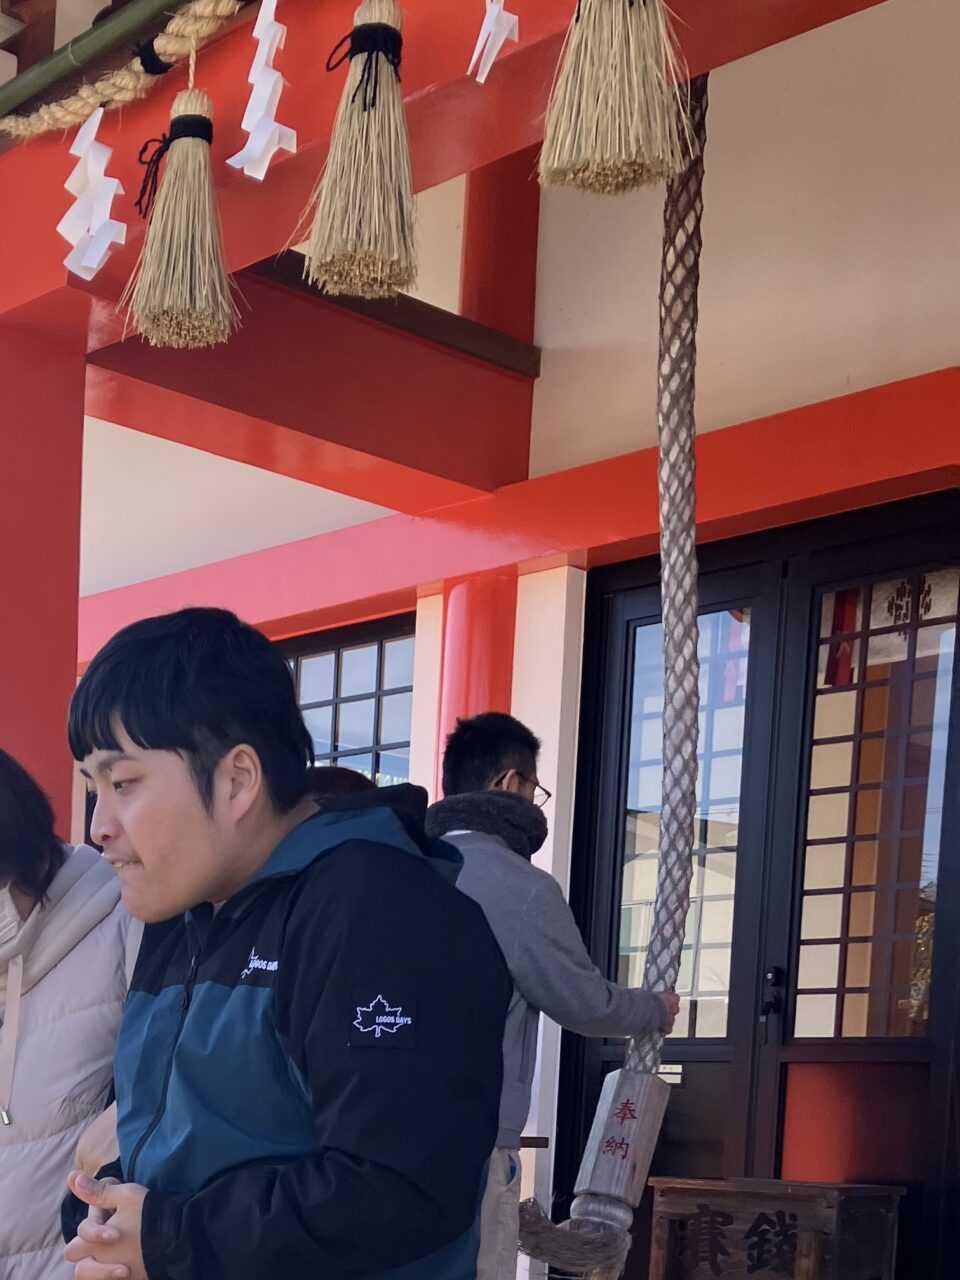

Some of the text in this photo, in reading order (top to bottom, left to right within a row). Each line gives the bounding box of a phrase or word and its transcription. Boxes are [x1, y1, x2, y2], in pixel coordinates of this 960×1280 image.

[375, 1015, 412, 1025] LOGOS DAYS
[603, 1098, 637, 1160] 奉納
